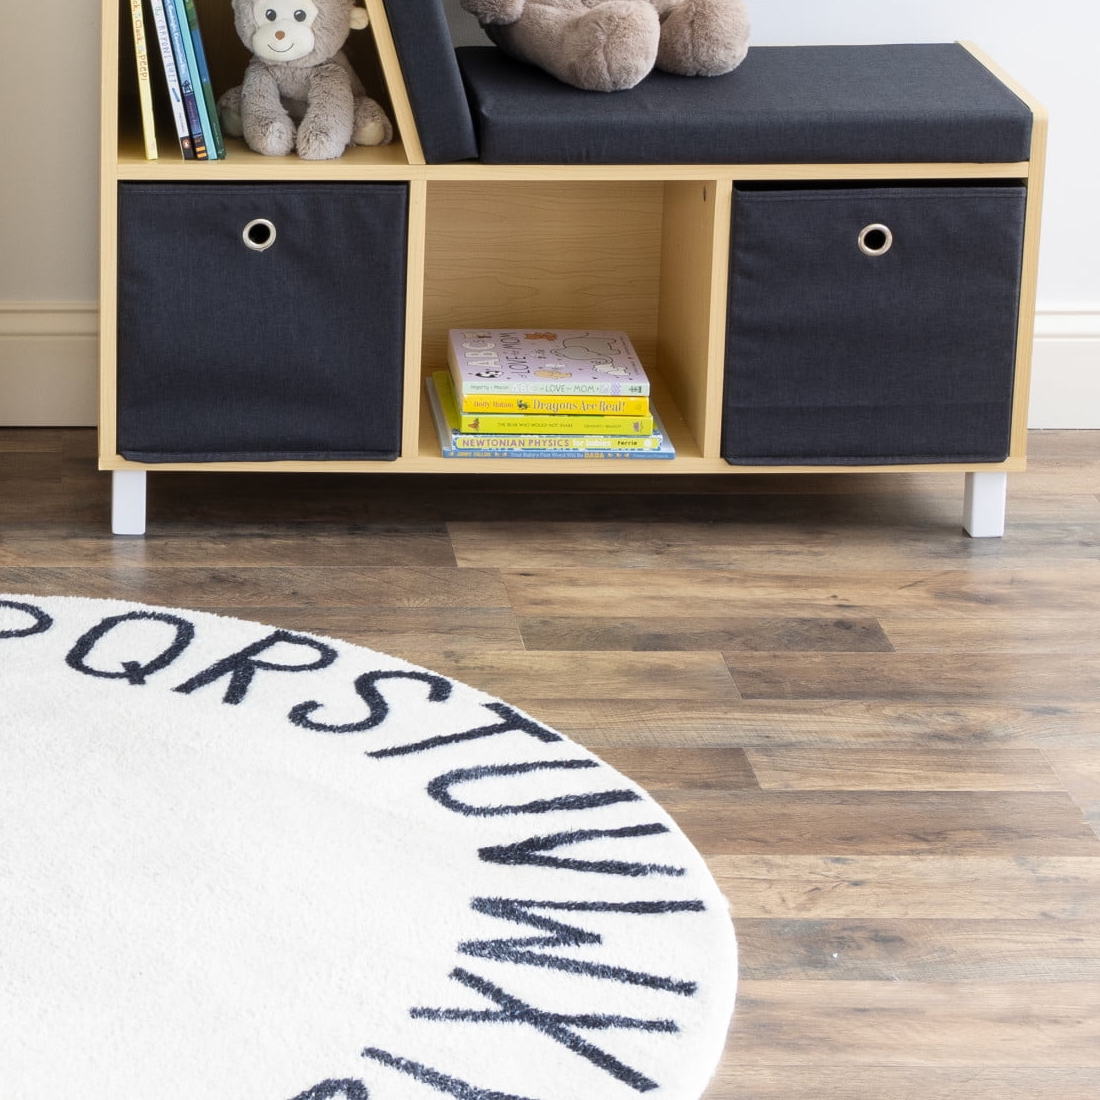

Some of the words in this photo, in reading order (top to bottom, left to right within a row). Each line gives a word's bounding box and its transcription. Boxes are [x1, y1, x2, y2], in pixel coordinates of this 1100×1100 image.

[134, 19, 143, 44] Clack,
[500, 332, 522, 349] MOM
[506, 356, 530, 373] LOVE
[545, 384, 565, 392] LOVE
[533, 398, 578, 412] Dragons
[580, 400, 597, 411] Are
[599, 401, 625, 412] Real!
[462, 439, 525, 447] NEWTONIAN
[529, 439, 569, 447] PHYSICS
